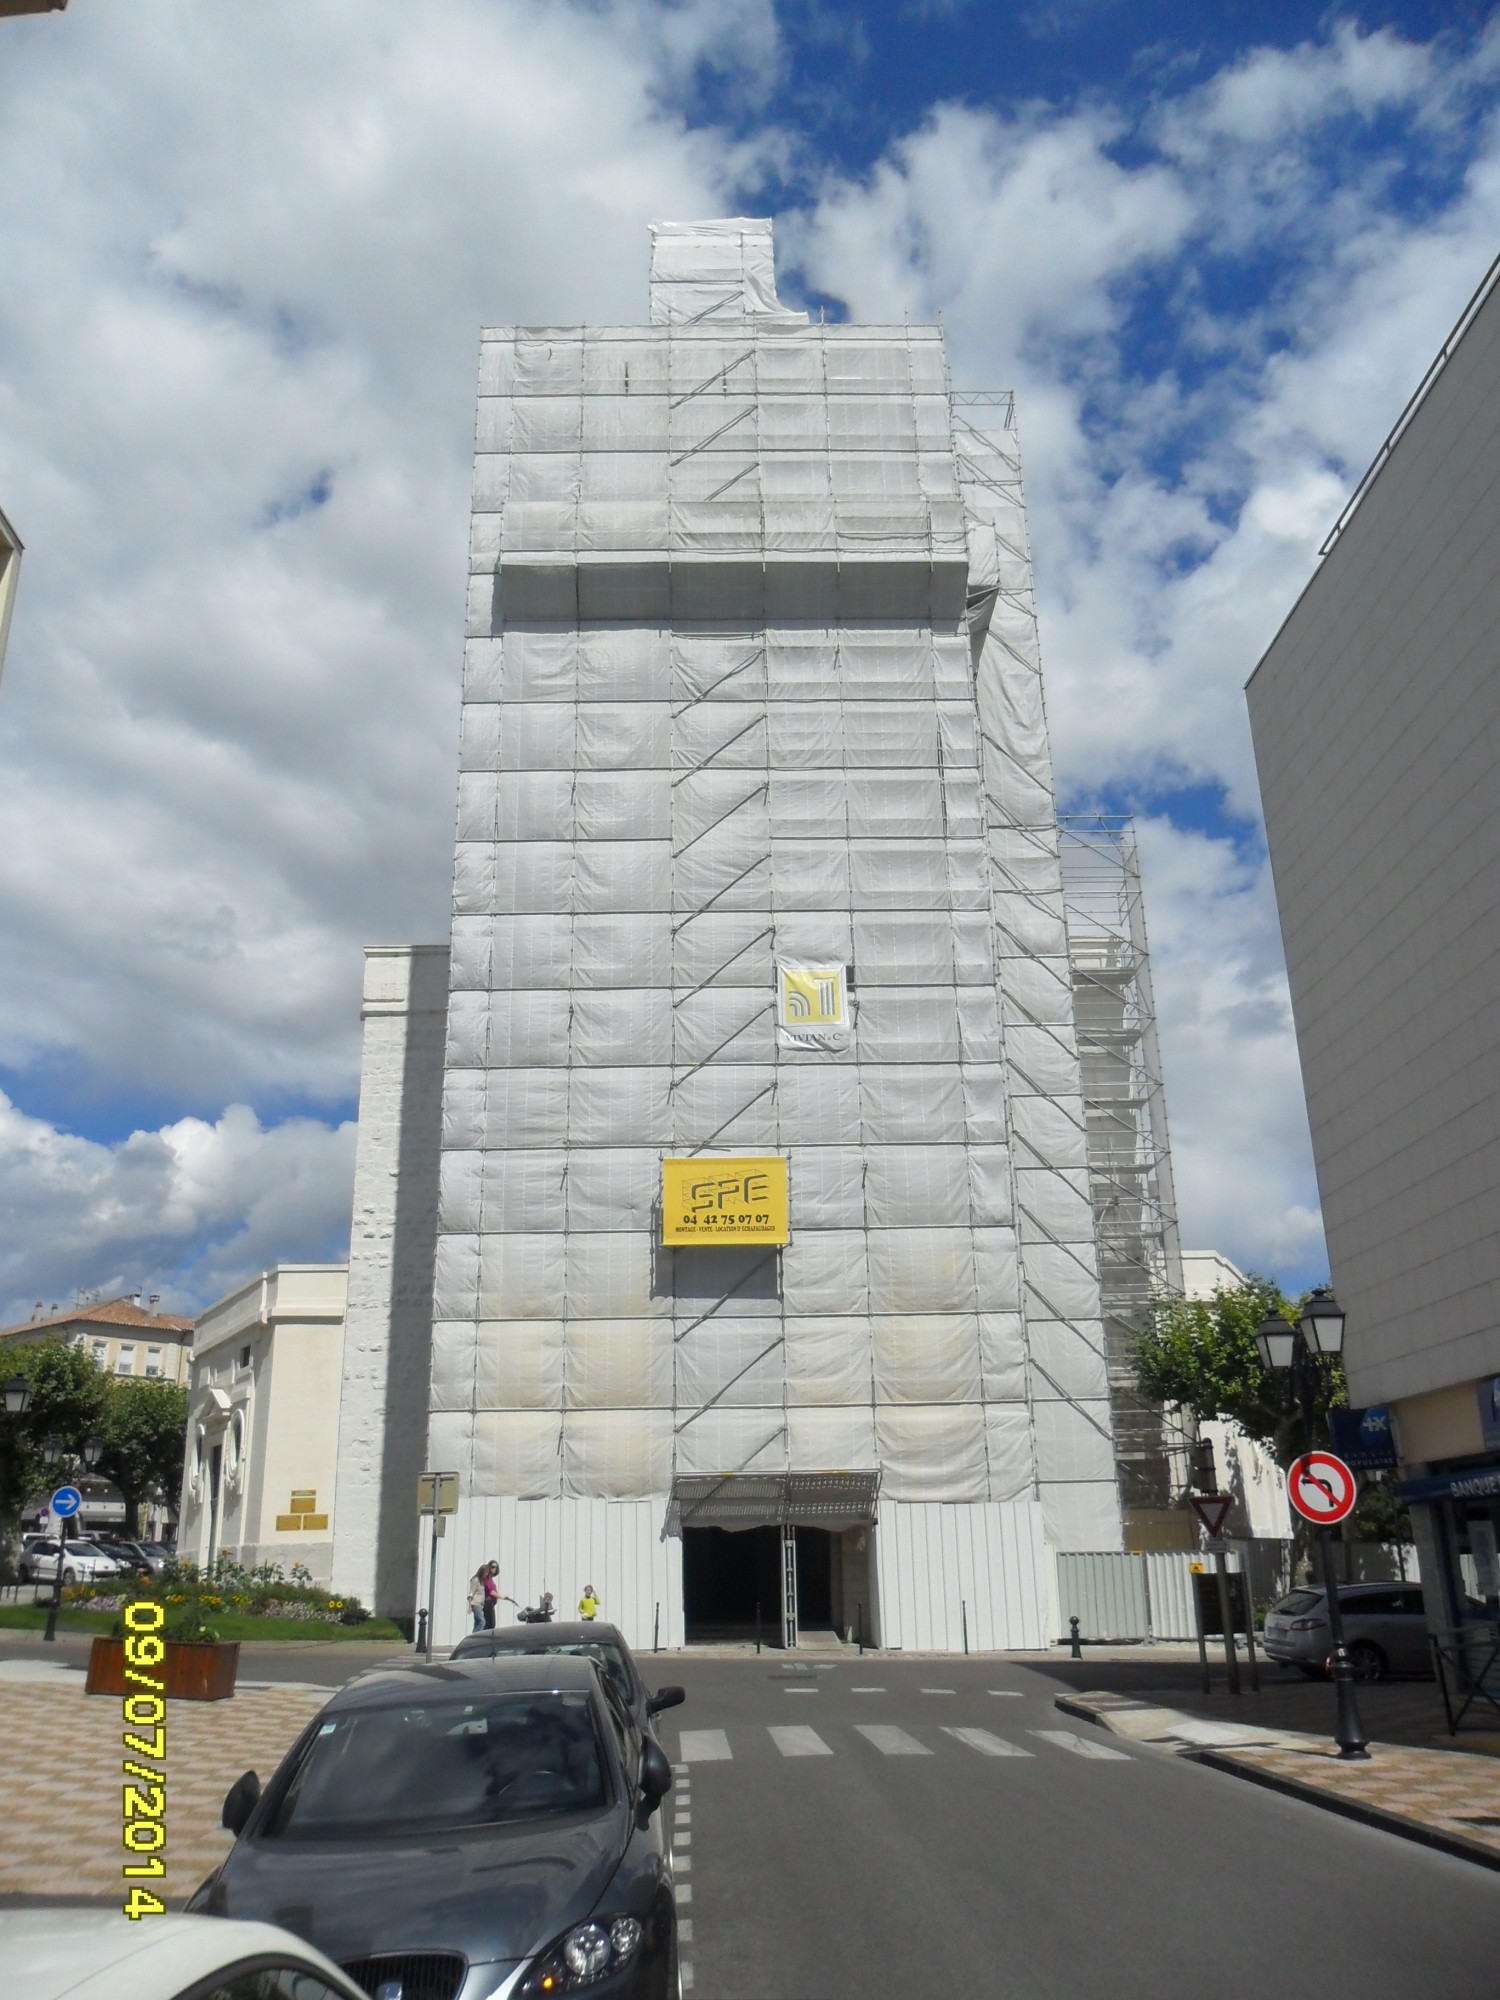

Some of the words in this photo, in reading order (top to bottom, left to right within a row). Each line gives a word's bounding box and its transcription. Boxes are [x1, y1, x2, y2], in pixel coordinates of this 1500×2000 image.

[690, 1173, 769, 1213] SPE
[683, 1215, 697, 1225] 04
[703, 1215, 718, 1225] 42
[721, 1215, 735, 1225] 75
[738, 1215, 751, 1225] 07
[755, 1214, 769, 1224] 07
[1450, 1477, 1498, 1497] BANQUE
